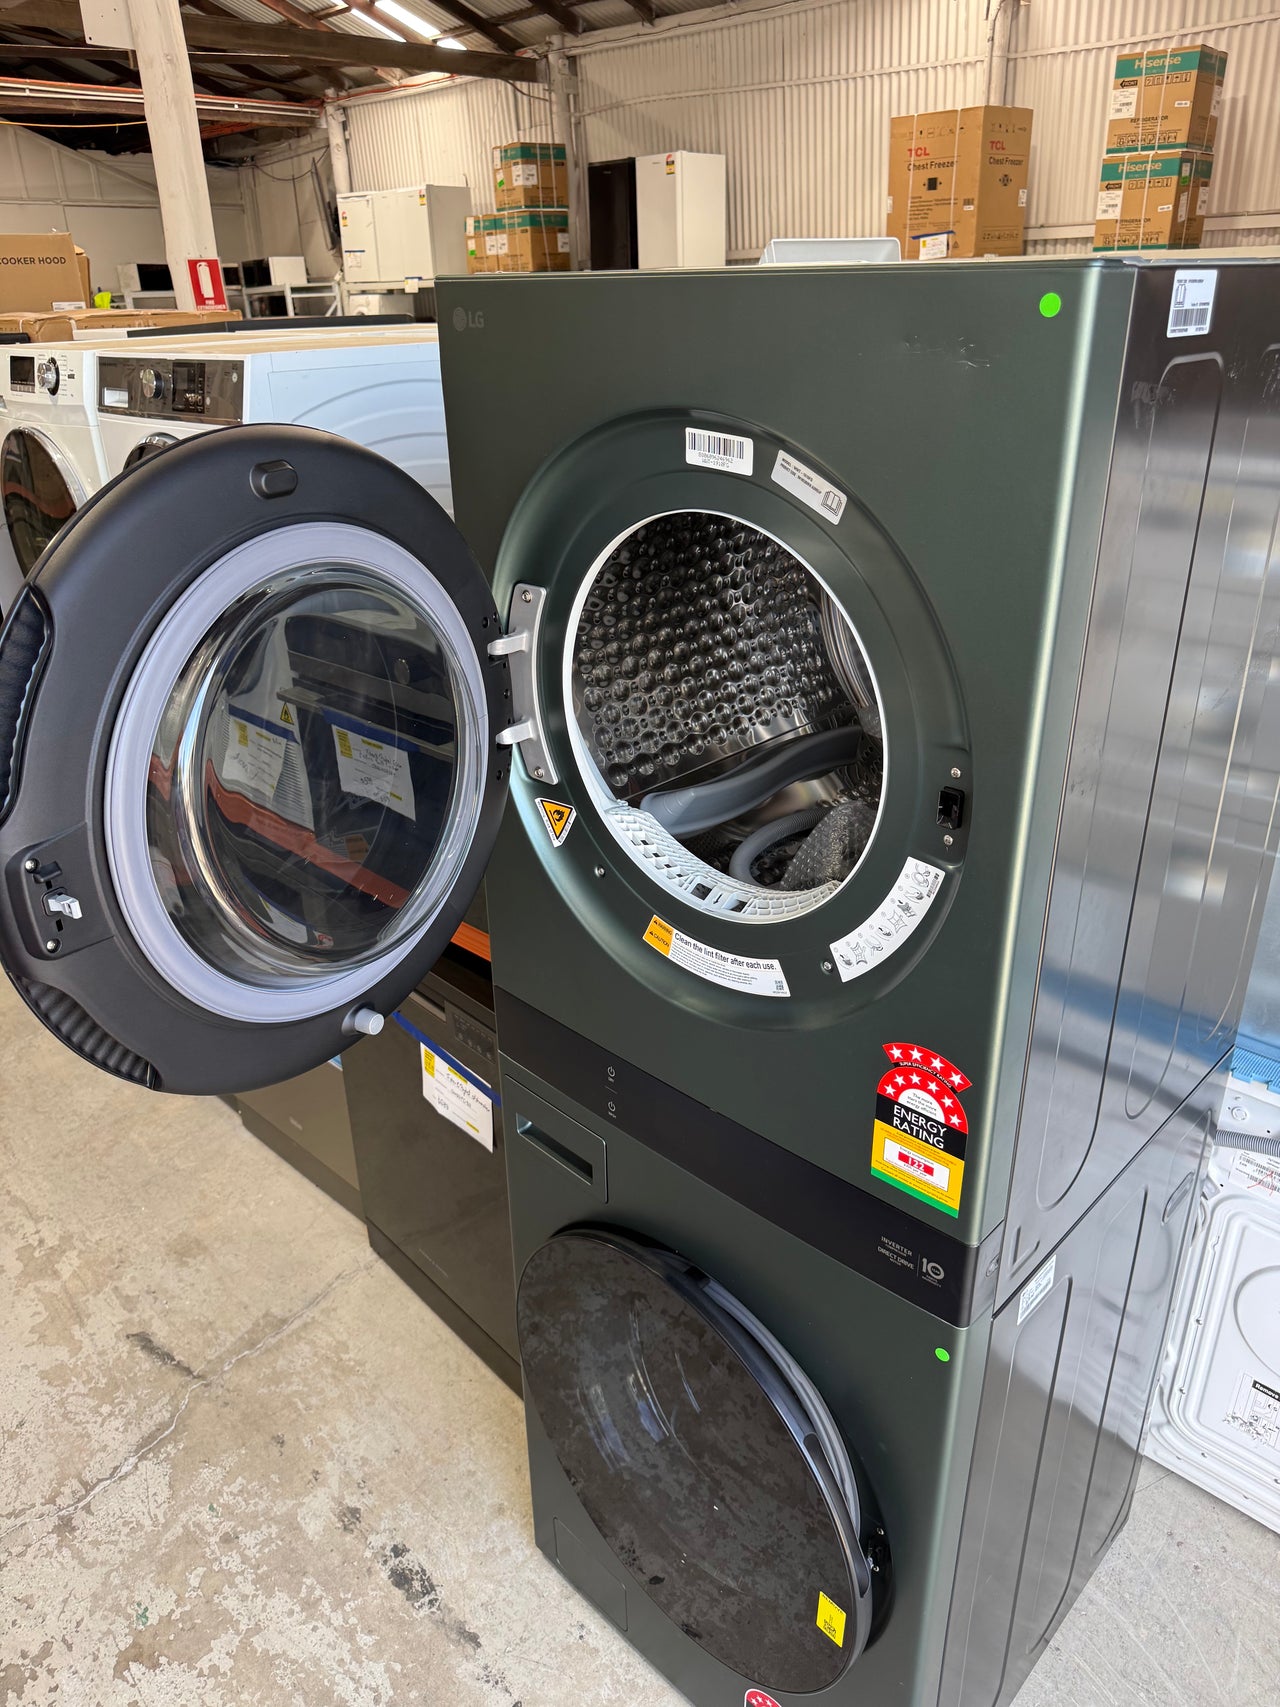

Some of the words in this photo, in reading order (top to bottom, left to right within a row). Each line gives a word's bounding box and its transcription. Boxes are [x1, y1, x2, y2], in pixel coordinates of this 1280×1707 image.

[1134, 56, 1182, 70] Hsense
[907, 147, 930, 158] TCL
[990, 140, 1006, 151] TCL
[907, 162, 929, 172] Chest
[988, 156, 1004, 166] Chest
[1005, 157, 1024, 166] Freezer
[1118, 162, 1162, 173] Hisense
[0, 256, 36, 265] OOKER
[38, 256, 67, 265] HOOD
[468, 311, 485, 329] LG
[653, 932, 670, 948] CAUTION
[674, 932, 692, 948] Clean
[692, 941, 703, 953] the
[703, 947, 715, 959] lint
[715, 951, 730, 964] filter
[730, 957, 745, 967] after
[745, 960, 761, 969] each
[762, 962, 777, 970] use.
[936, 1073, 952, 1089] RATING
[906, 1100, 920, 1111] energy
[922, 1097, 933, 1106] more
[925, 1103, 937, 1112] more
[893, 1104, 947, 1137] ENERGY
[893, 1116, 945, 1149] RATING
[908, 1157, 925, 1172] 122
[881, 1236, 912, 1256] INVERTER
[878, 1246, 897, 1260] DIRECT
[897, 1257, 914, 1269] DRIVE
[922, 1258, 944, 1280] 10
[1255, 1383, 1280, 1400] Remove
